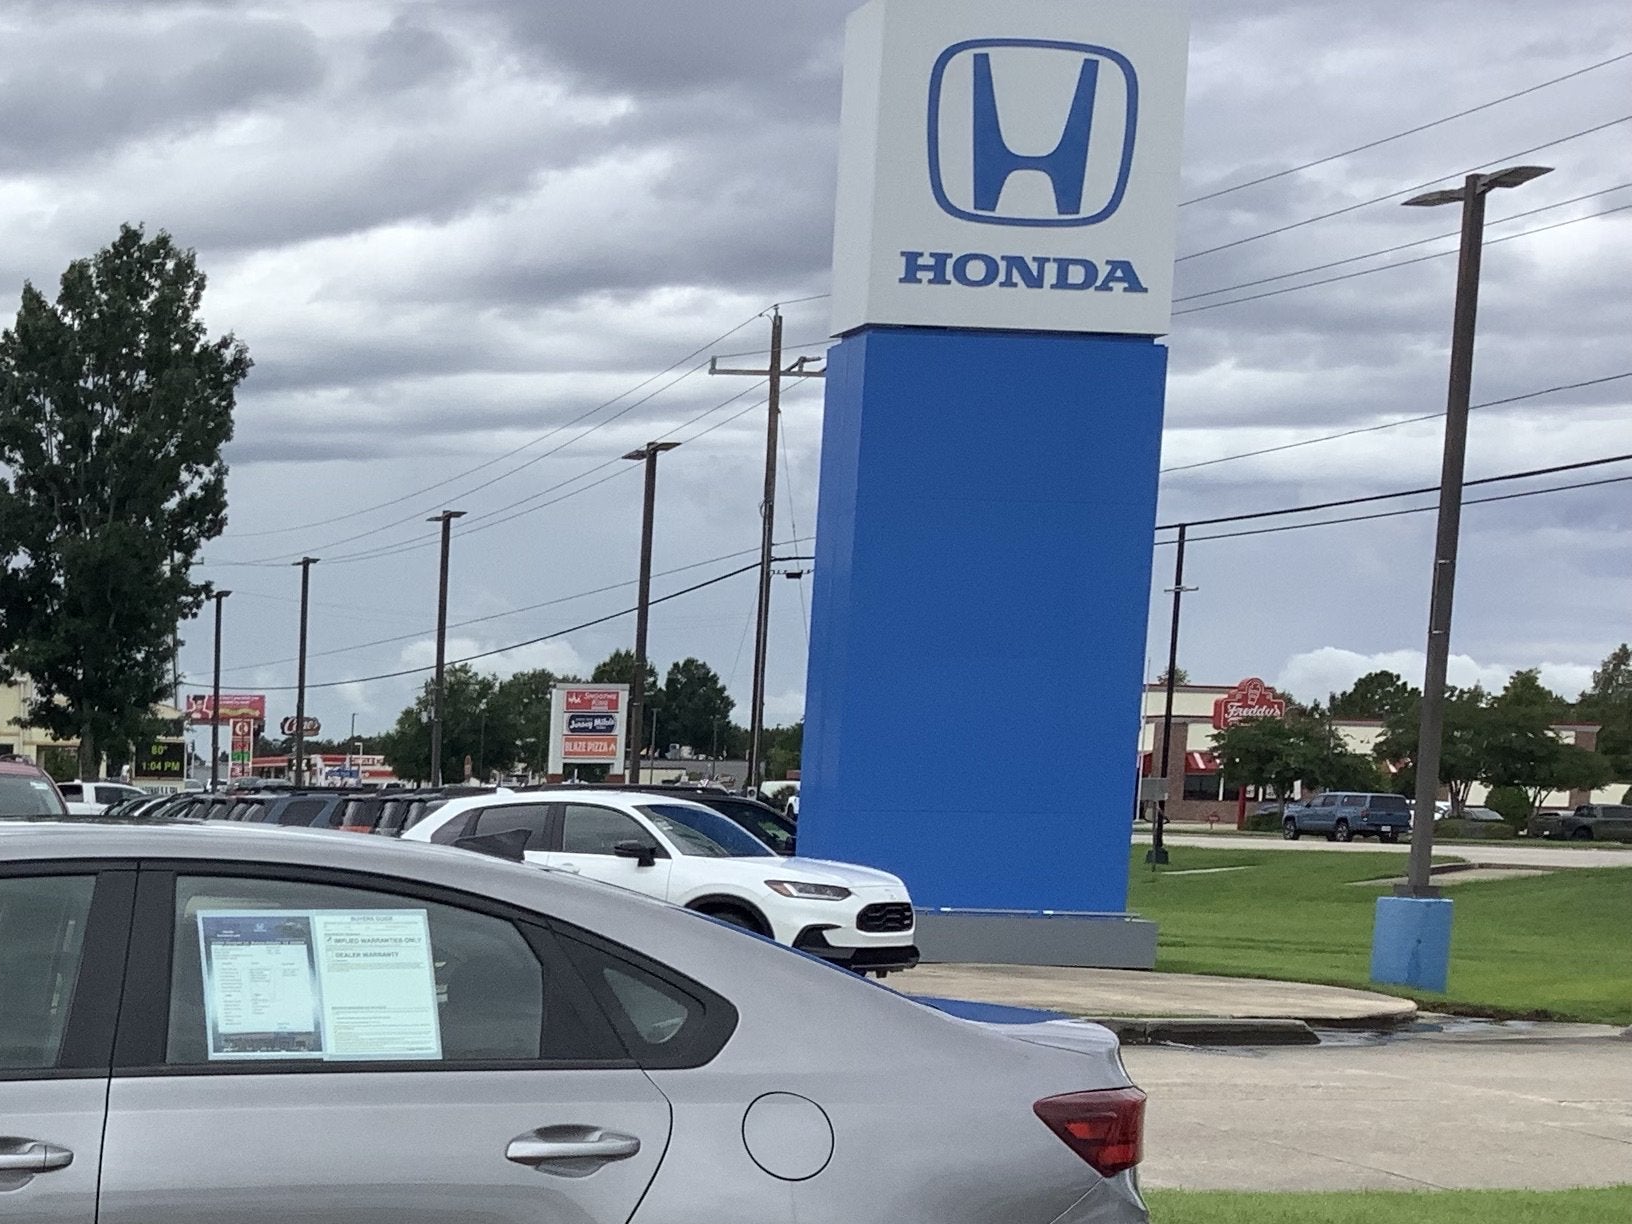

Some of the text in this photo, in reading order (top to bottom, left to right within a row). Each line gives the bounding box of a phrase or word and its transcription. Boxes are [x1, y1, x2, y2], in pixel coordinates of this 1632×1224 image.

[898, 250, 1149, 294] HONDA
[1224, 702, 1281, 719] Freddy's
[570, 720, 593, 729] Jersey
[594, 718, 615, 726] Mike's
[564, 741, 608, 752] BLAZE PIZZA
[142, 761, 180, 771] 1:04 PM
